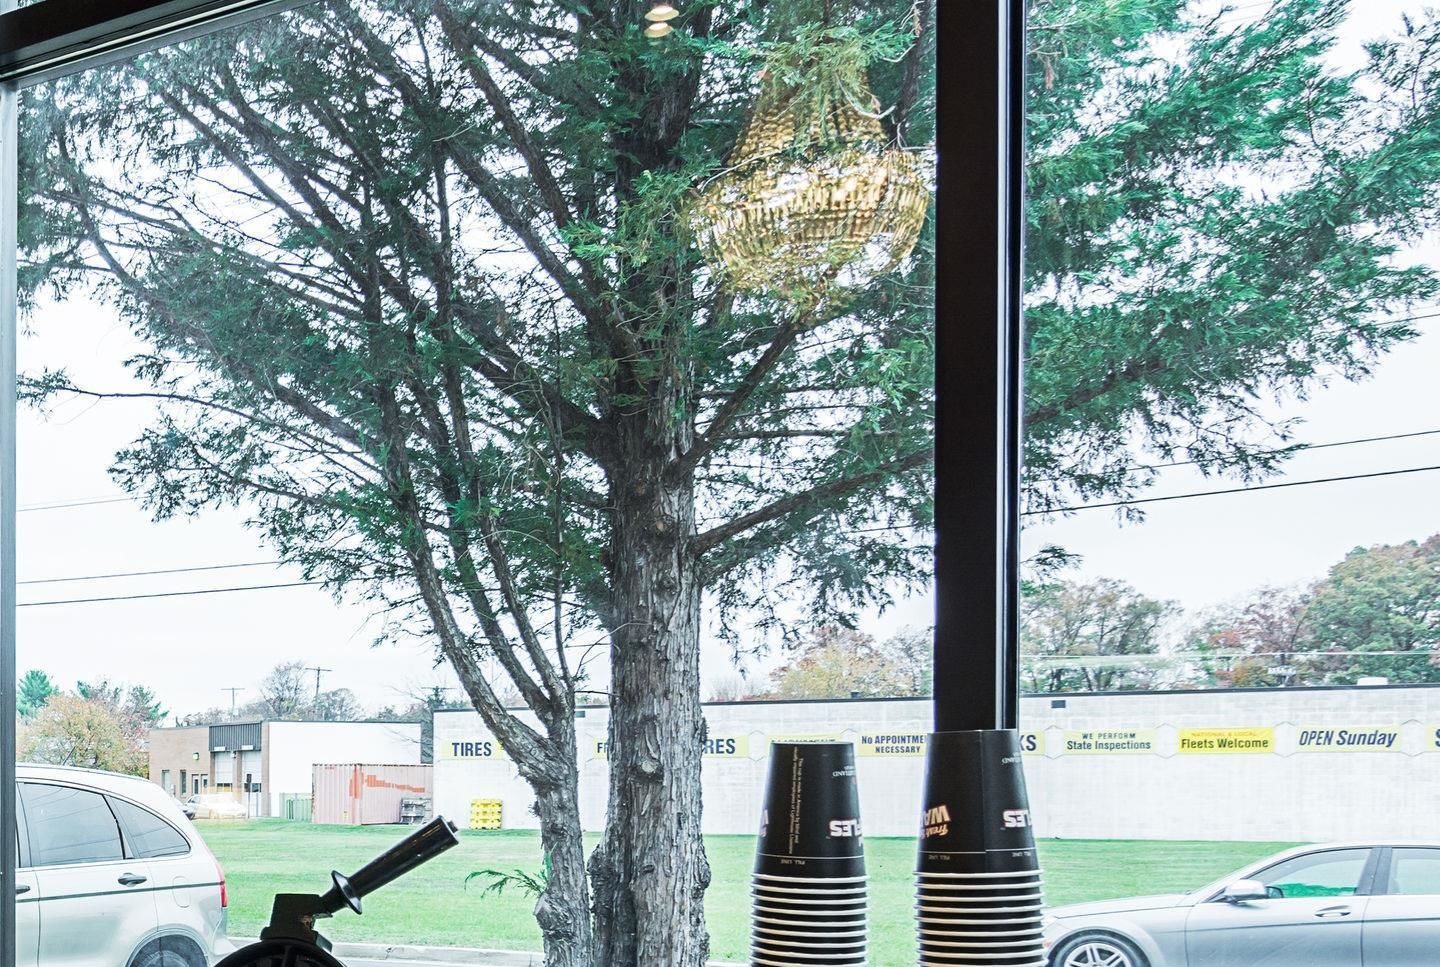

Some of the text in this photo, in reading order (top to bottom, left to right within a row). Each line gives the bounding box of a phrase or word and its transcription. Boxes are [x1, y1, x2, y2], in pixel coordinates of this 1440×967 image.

[874, 735, 926, 744] APPOINTME
[1181, 738, 1269, 749] Fleets Welcome
[1299, 730, 1398, 748] OPEN Sunday
[452, 742, 492, 757] TIRES
[875, 746, 921, 754] NECESSARY
[1067, 740, 1151, 751] State Inspections
